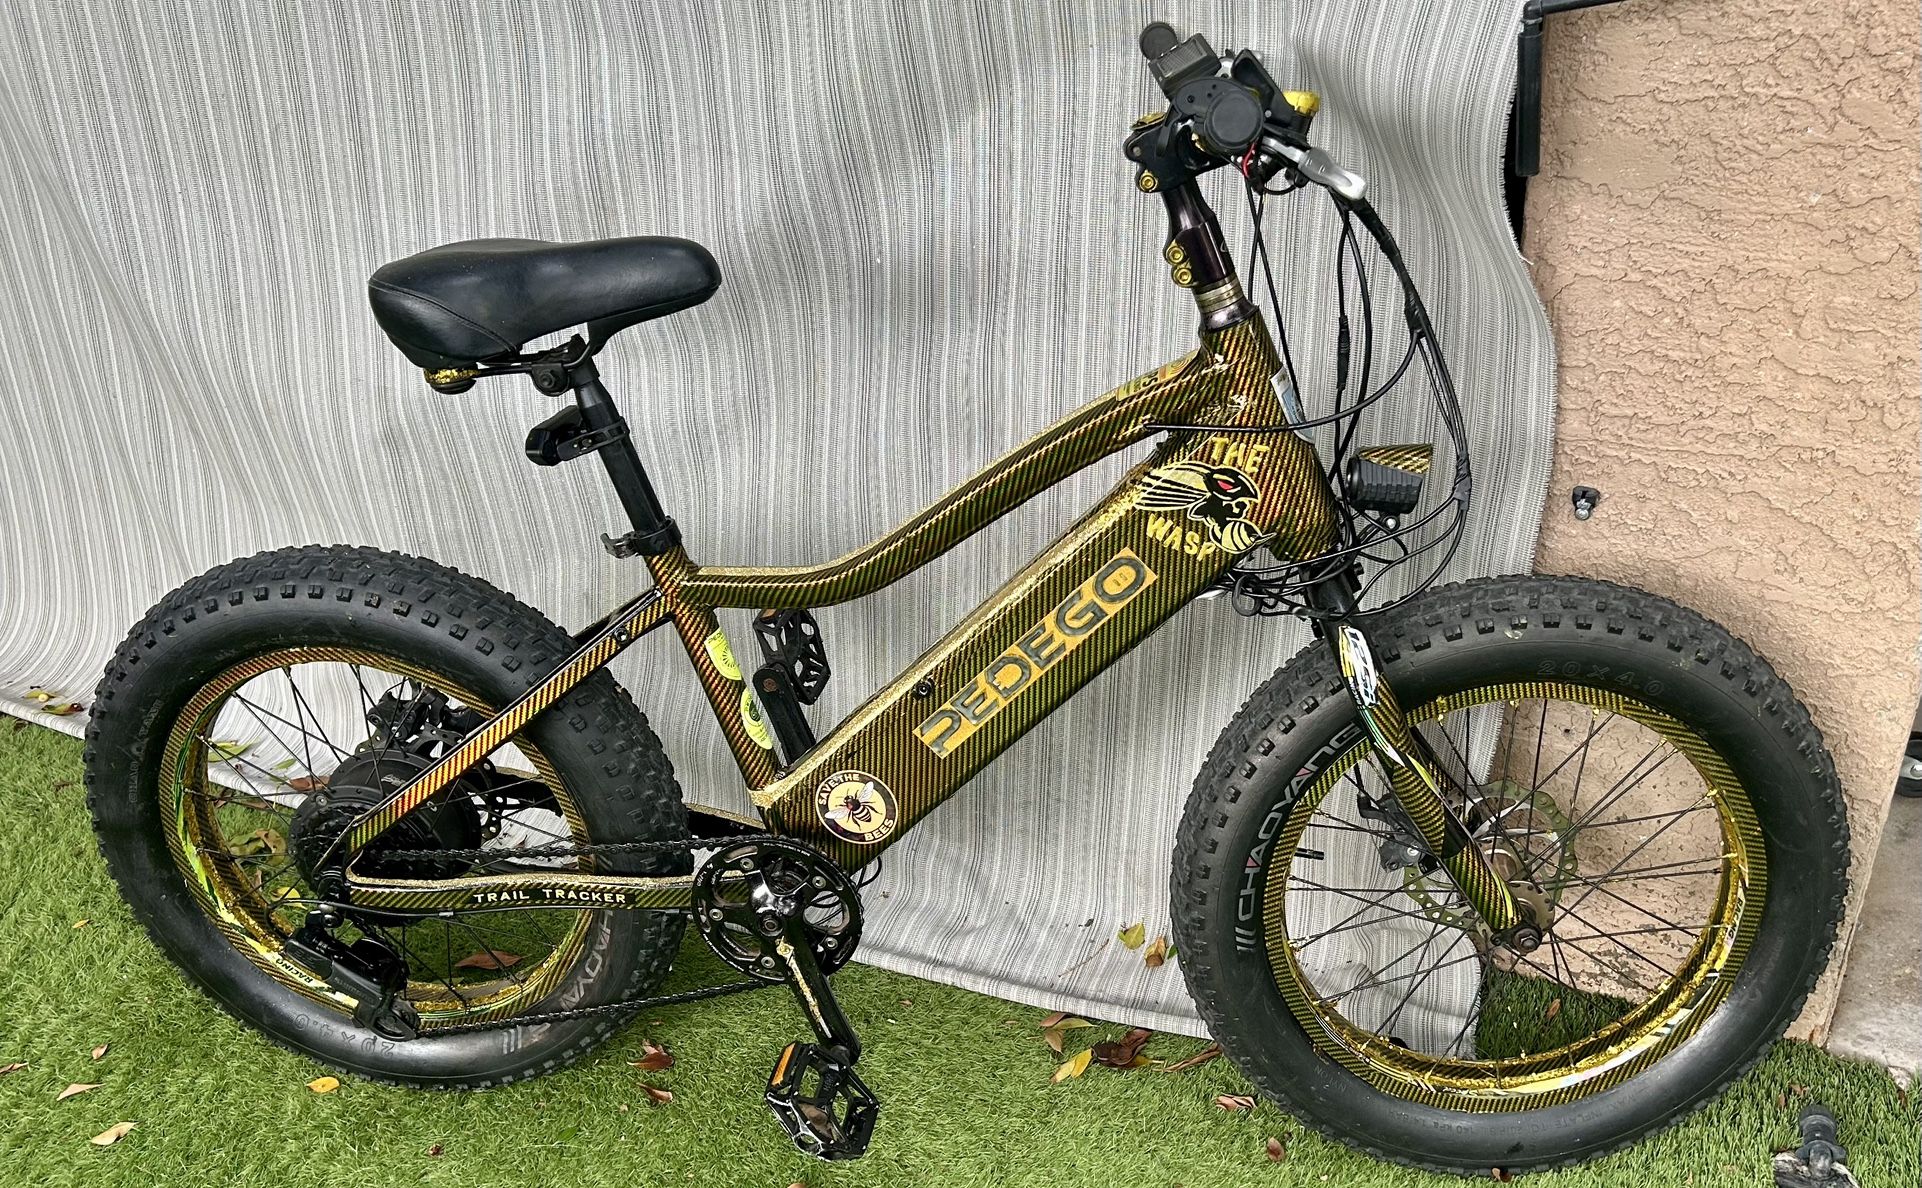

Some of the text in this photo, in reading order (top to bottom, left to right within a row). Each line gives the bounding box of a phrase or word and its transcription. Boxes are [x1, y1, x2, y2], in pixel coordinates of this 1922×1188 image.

[1211, 437, 1270, 473] THE
[1146, 513, 1216, 562] WASP
[919, 556, 1148, 754] PEDEGO
[818, 773, 860, 806] SAVE THE
[864, 818, 894, 841] BEES
[1237, 722, 1363, 922] CHAOYANG
[473, 888, 626, 904] TRAIL TRACKER
